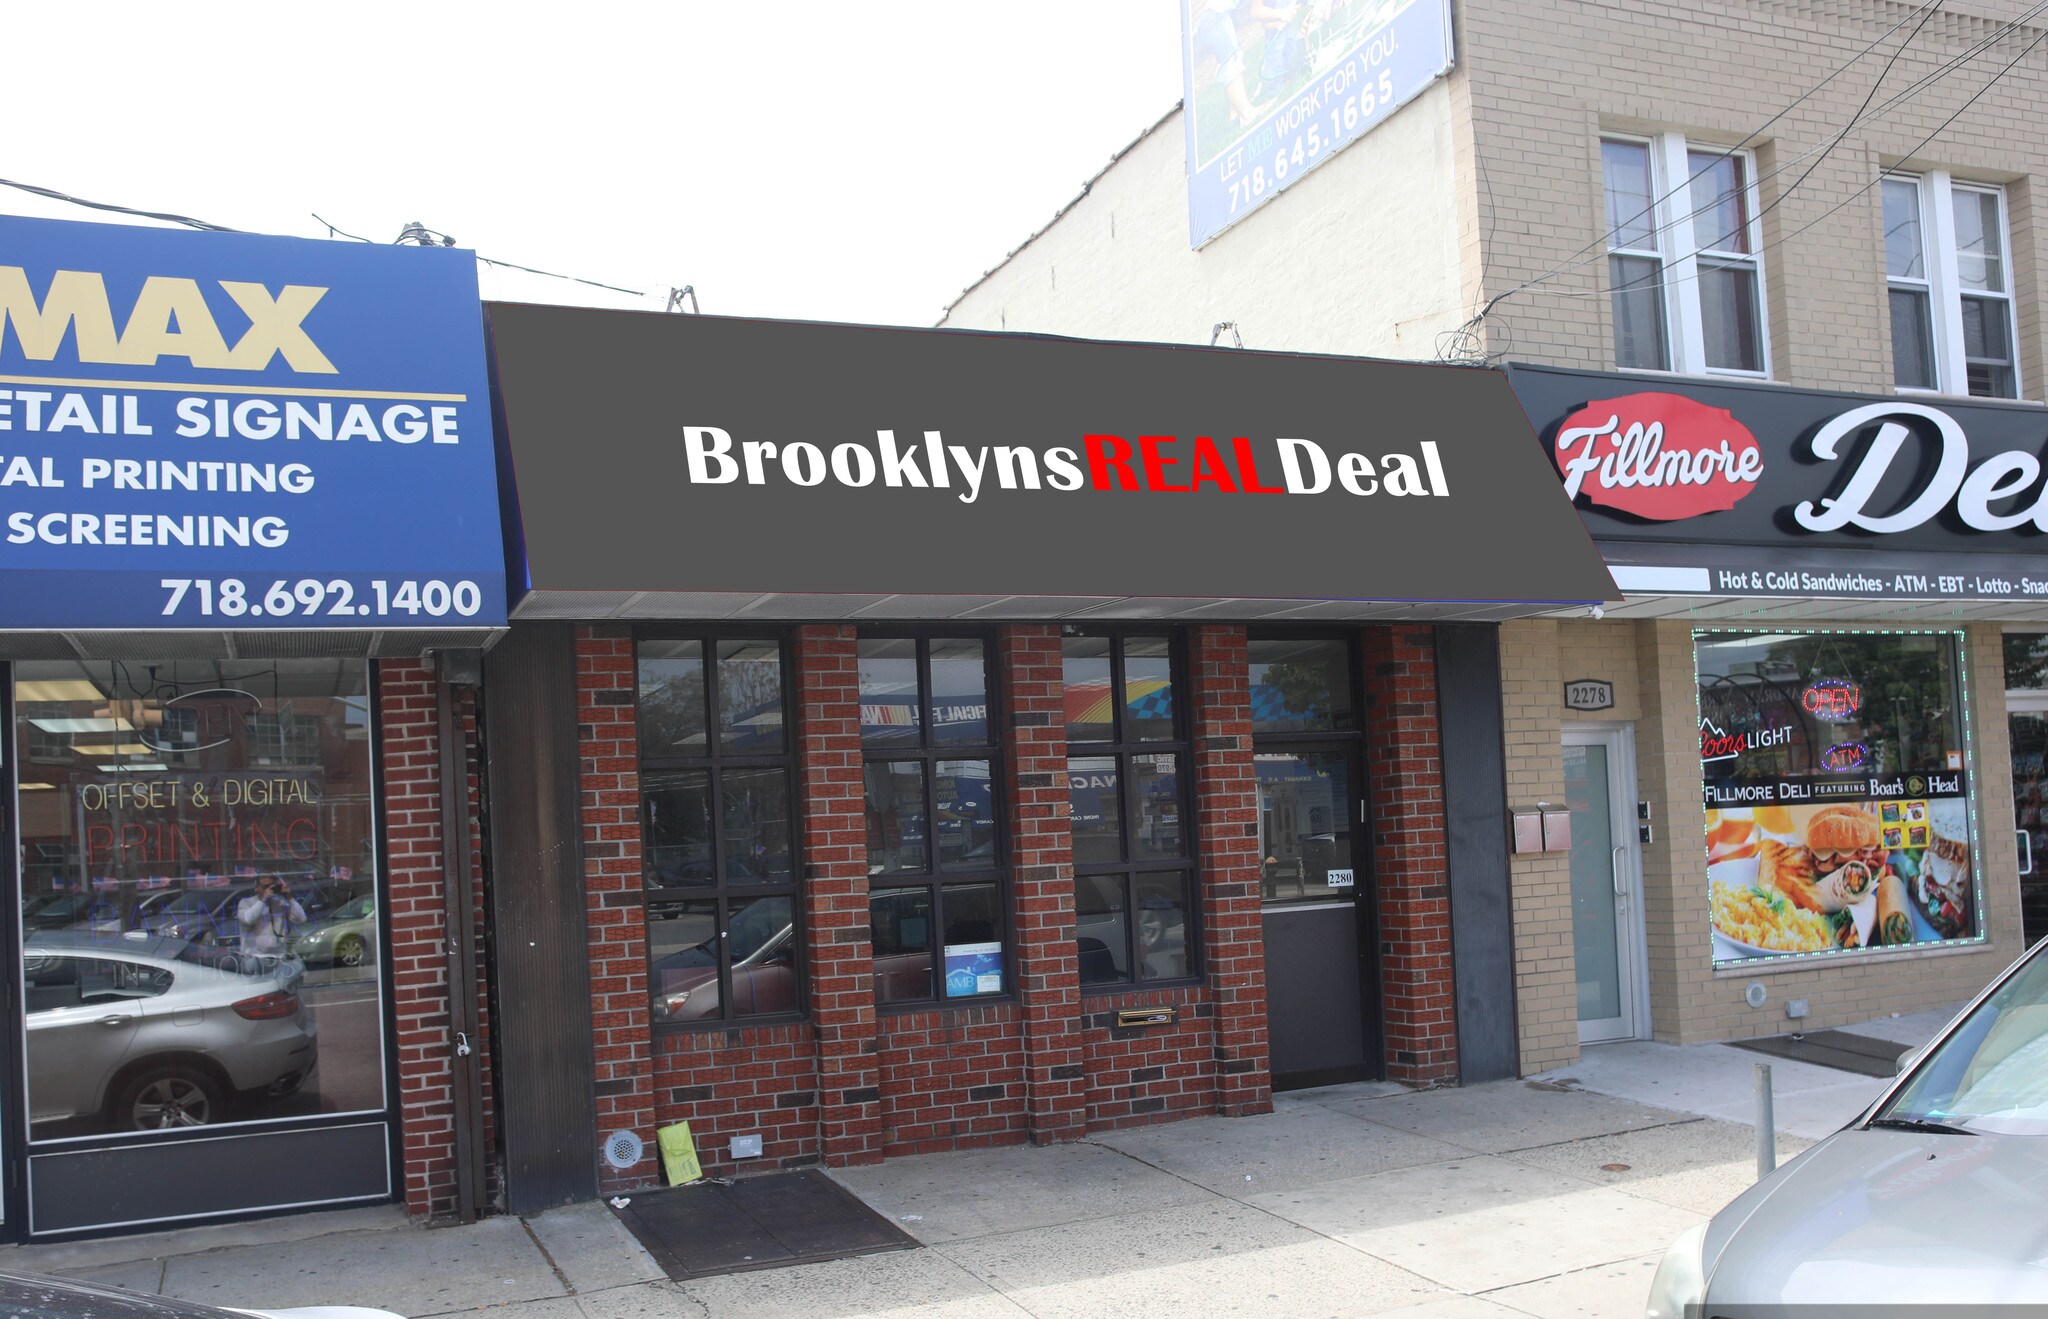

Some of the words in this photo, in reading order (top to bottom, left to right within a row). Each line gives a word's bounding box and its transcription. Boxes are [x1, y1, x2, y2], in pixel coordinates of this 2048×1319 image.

[1219, 147, 1244, 183] LET
[1275, 86, 1322, 140] WORK
[1323, 61, 1357, 102] FOR
[1360, 28, 1400, 75] YOU.
[1227, 68, 1394, 215] 718.645.1665
[0, 264, 340, 374] MAX
[175, 397, 459, 445] SIGNAGE
[0, 455, 65, 488] AL
[82, 458, 315, 494] PRINTING
[1558, 413, 1765, 500] Fillmore
[7, 512, 290, 548] SCREENING
[160, 578, 482, 618] 718.692.1400
[1719, 570, 1749, 590] Hot
[1751, 571, 1763, 590] &
[1765, 571, 1799, 591] Cold
[1801, 572, 1883, 592] Sandwiches
[1894, 575, 1928, 593] ATM
[1938, 576, 1965, 593] EBT
[1976, 576, 2012, 594] Lotto
[1572, 686, 1606, 704] 2278
[1803, 687, 1860, 712] OPEN
[1747, 726, 1793, 750] LIGHT
[1829, 748, 1861, 768] ATM
[82, 780, 181, 811] OFFSET
[191, 781, 211, 808] &
[223, 778, 318, 806] DIGITAL
[1704, 784, 1774, 803] FILLMORE
[1780, 783, 1811, 799] DELI
[1815, 784, 1866, 794] FEATURING
[1870, 778, 1904, 796] Boar's
[1928, 775, 1959, 794] Head
[87, 817, 319, 866] PRINTING
[1328, 871, 1353, 885] 2280
